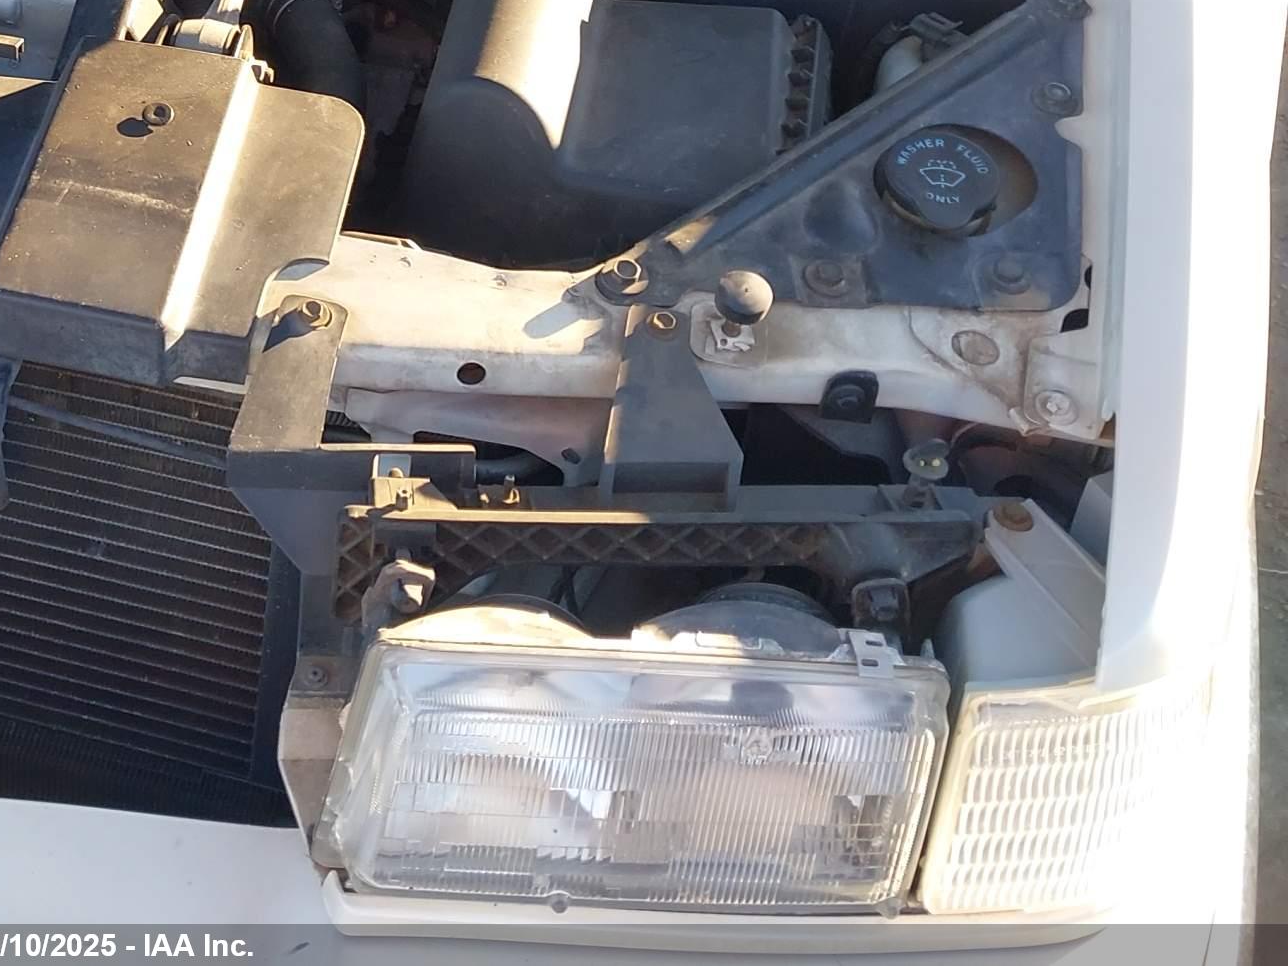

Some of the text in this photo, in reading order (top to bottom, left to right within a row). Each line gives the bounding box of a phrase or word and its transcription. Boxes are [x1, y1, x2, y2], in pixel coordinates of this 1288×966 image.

[896, 138, 989, 174] WASHER FLUID
[926, 192, 960, 204] ONLY
